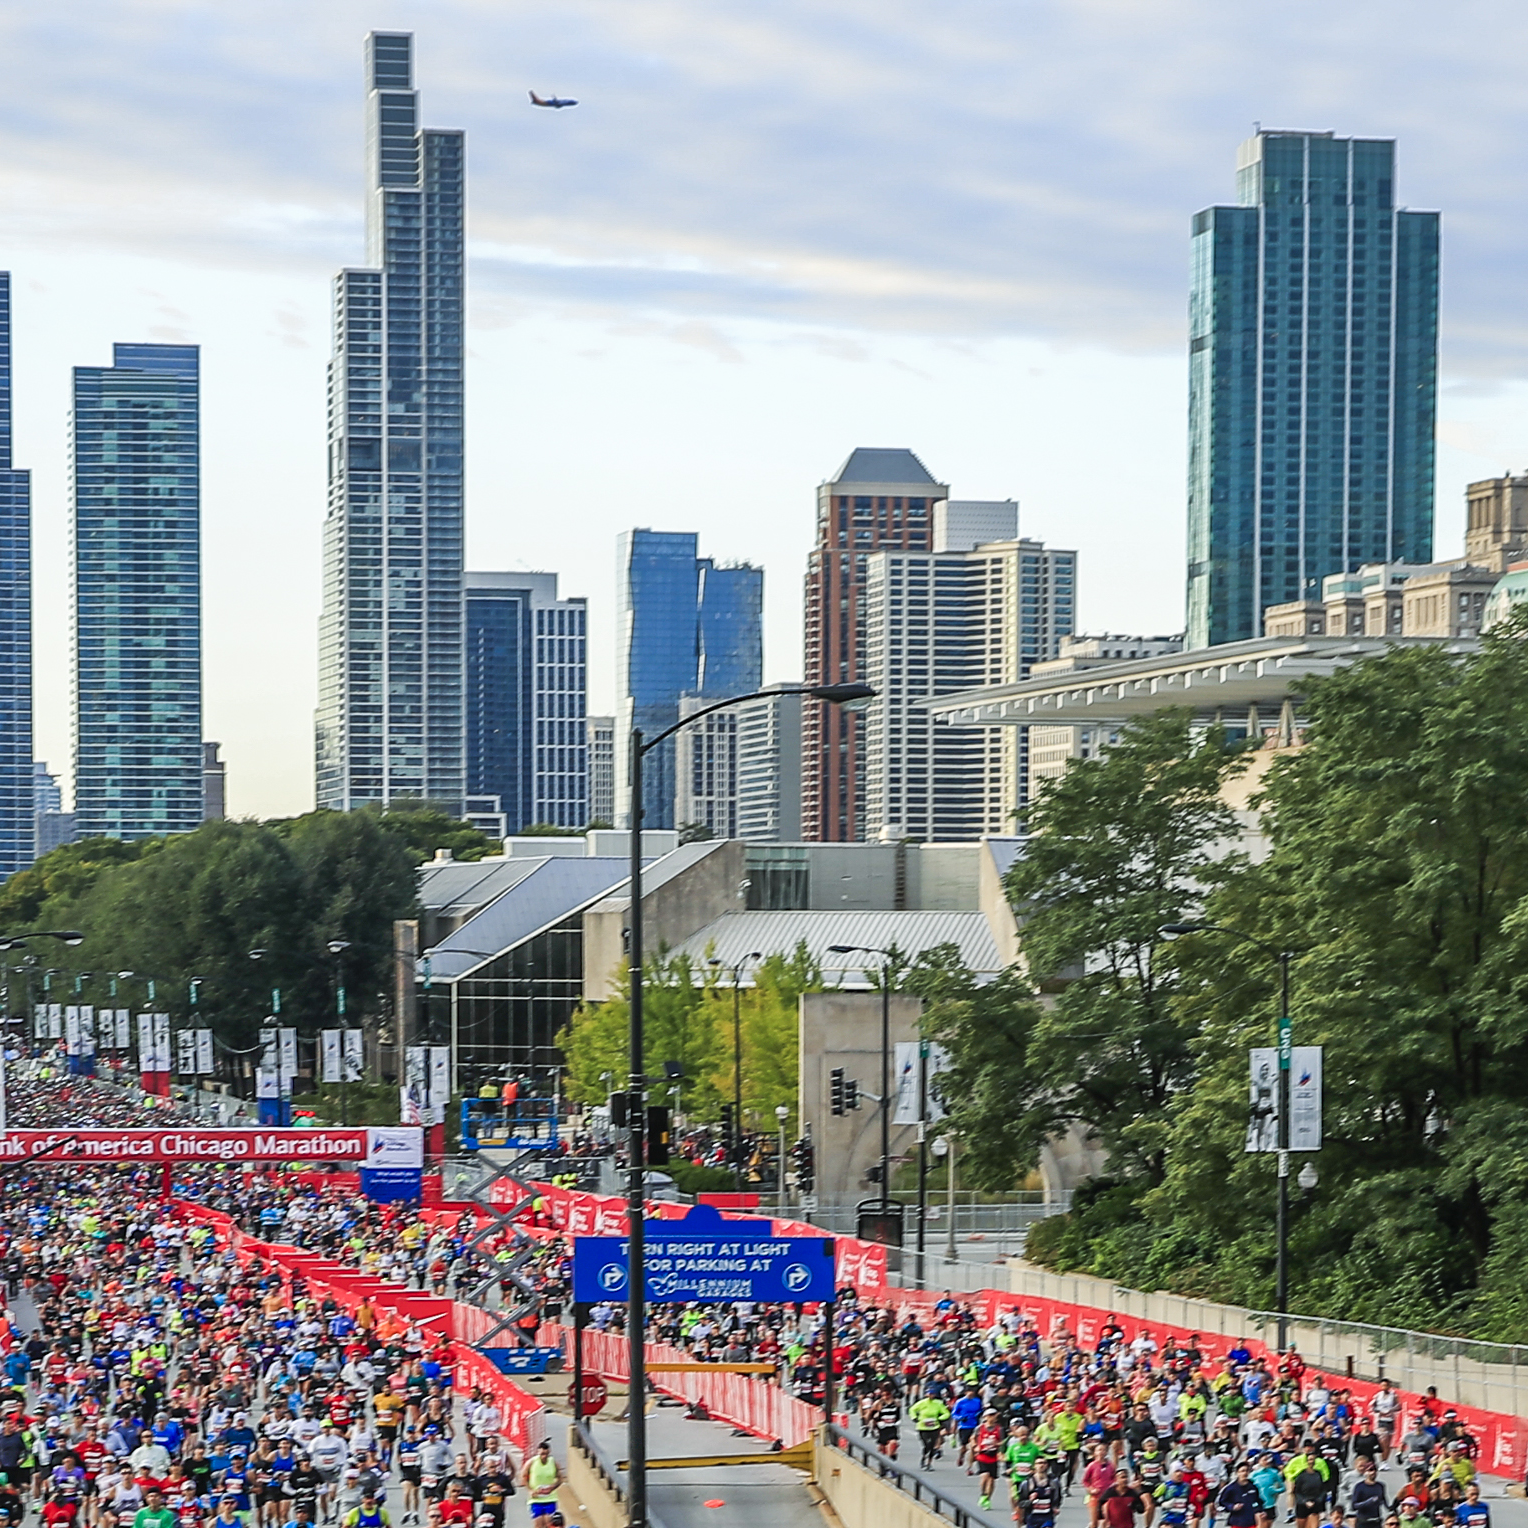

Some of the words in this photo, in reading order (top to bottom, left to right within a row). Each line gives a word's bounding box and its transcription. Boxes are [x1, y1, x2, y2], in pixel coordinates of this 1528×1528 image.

[160, 1133, 248, 1159] Chicago
[254, 1132, 361, 1156] Marathon
[619, 1243, 663, 1256] TRN
[667, 1243, 716, 1256] RIGHT
[718, 1243, 741, 1256] AT
[744, 1243, 791, 1256] LIGHT
[675, 1259, 747, 1272] PARKING
[749, 1259, 773, 1272] AT
